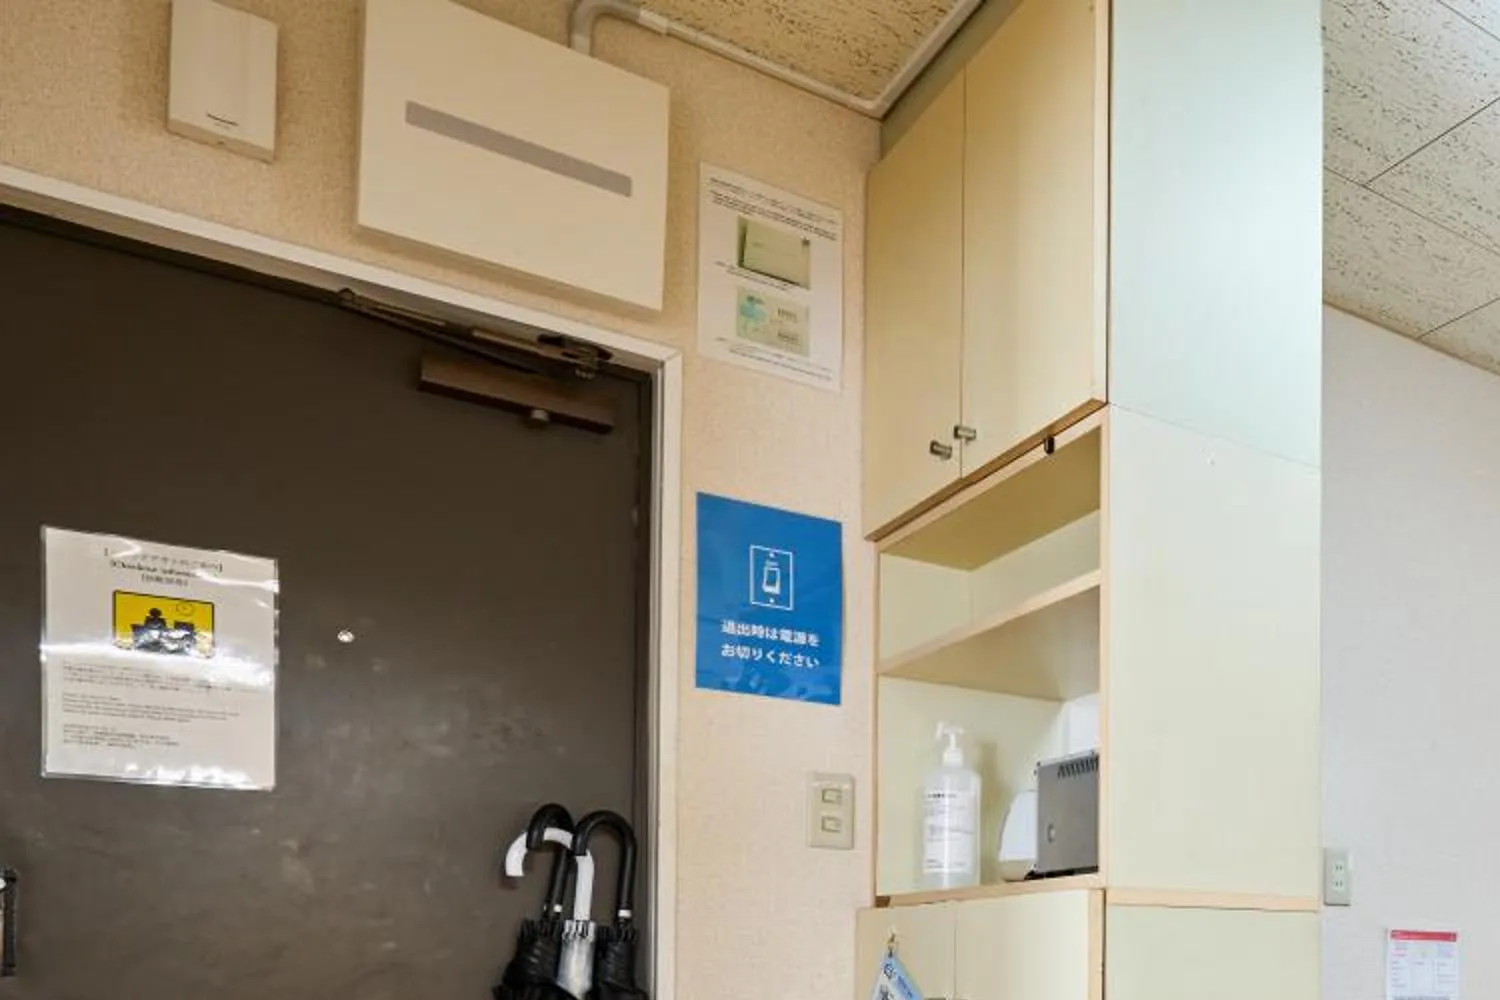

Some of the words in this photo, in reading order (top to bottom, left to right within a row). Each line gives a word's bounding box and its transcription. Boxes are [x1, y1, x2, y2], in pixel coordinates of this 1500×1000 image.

[720, 643, 820, 669] お切りください
